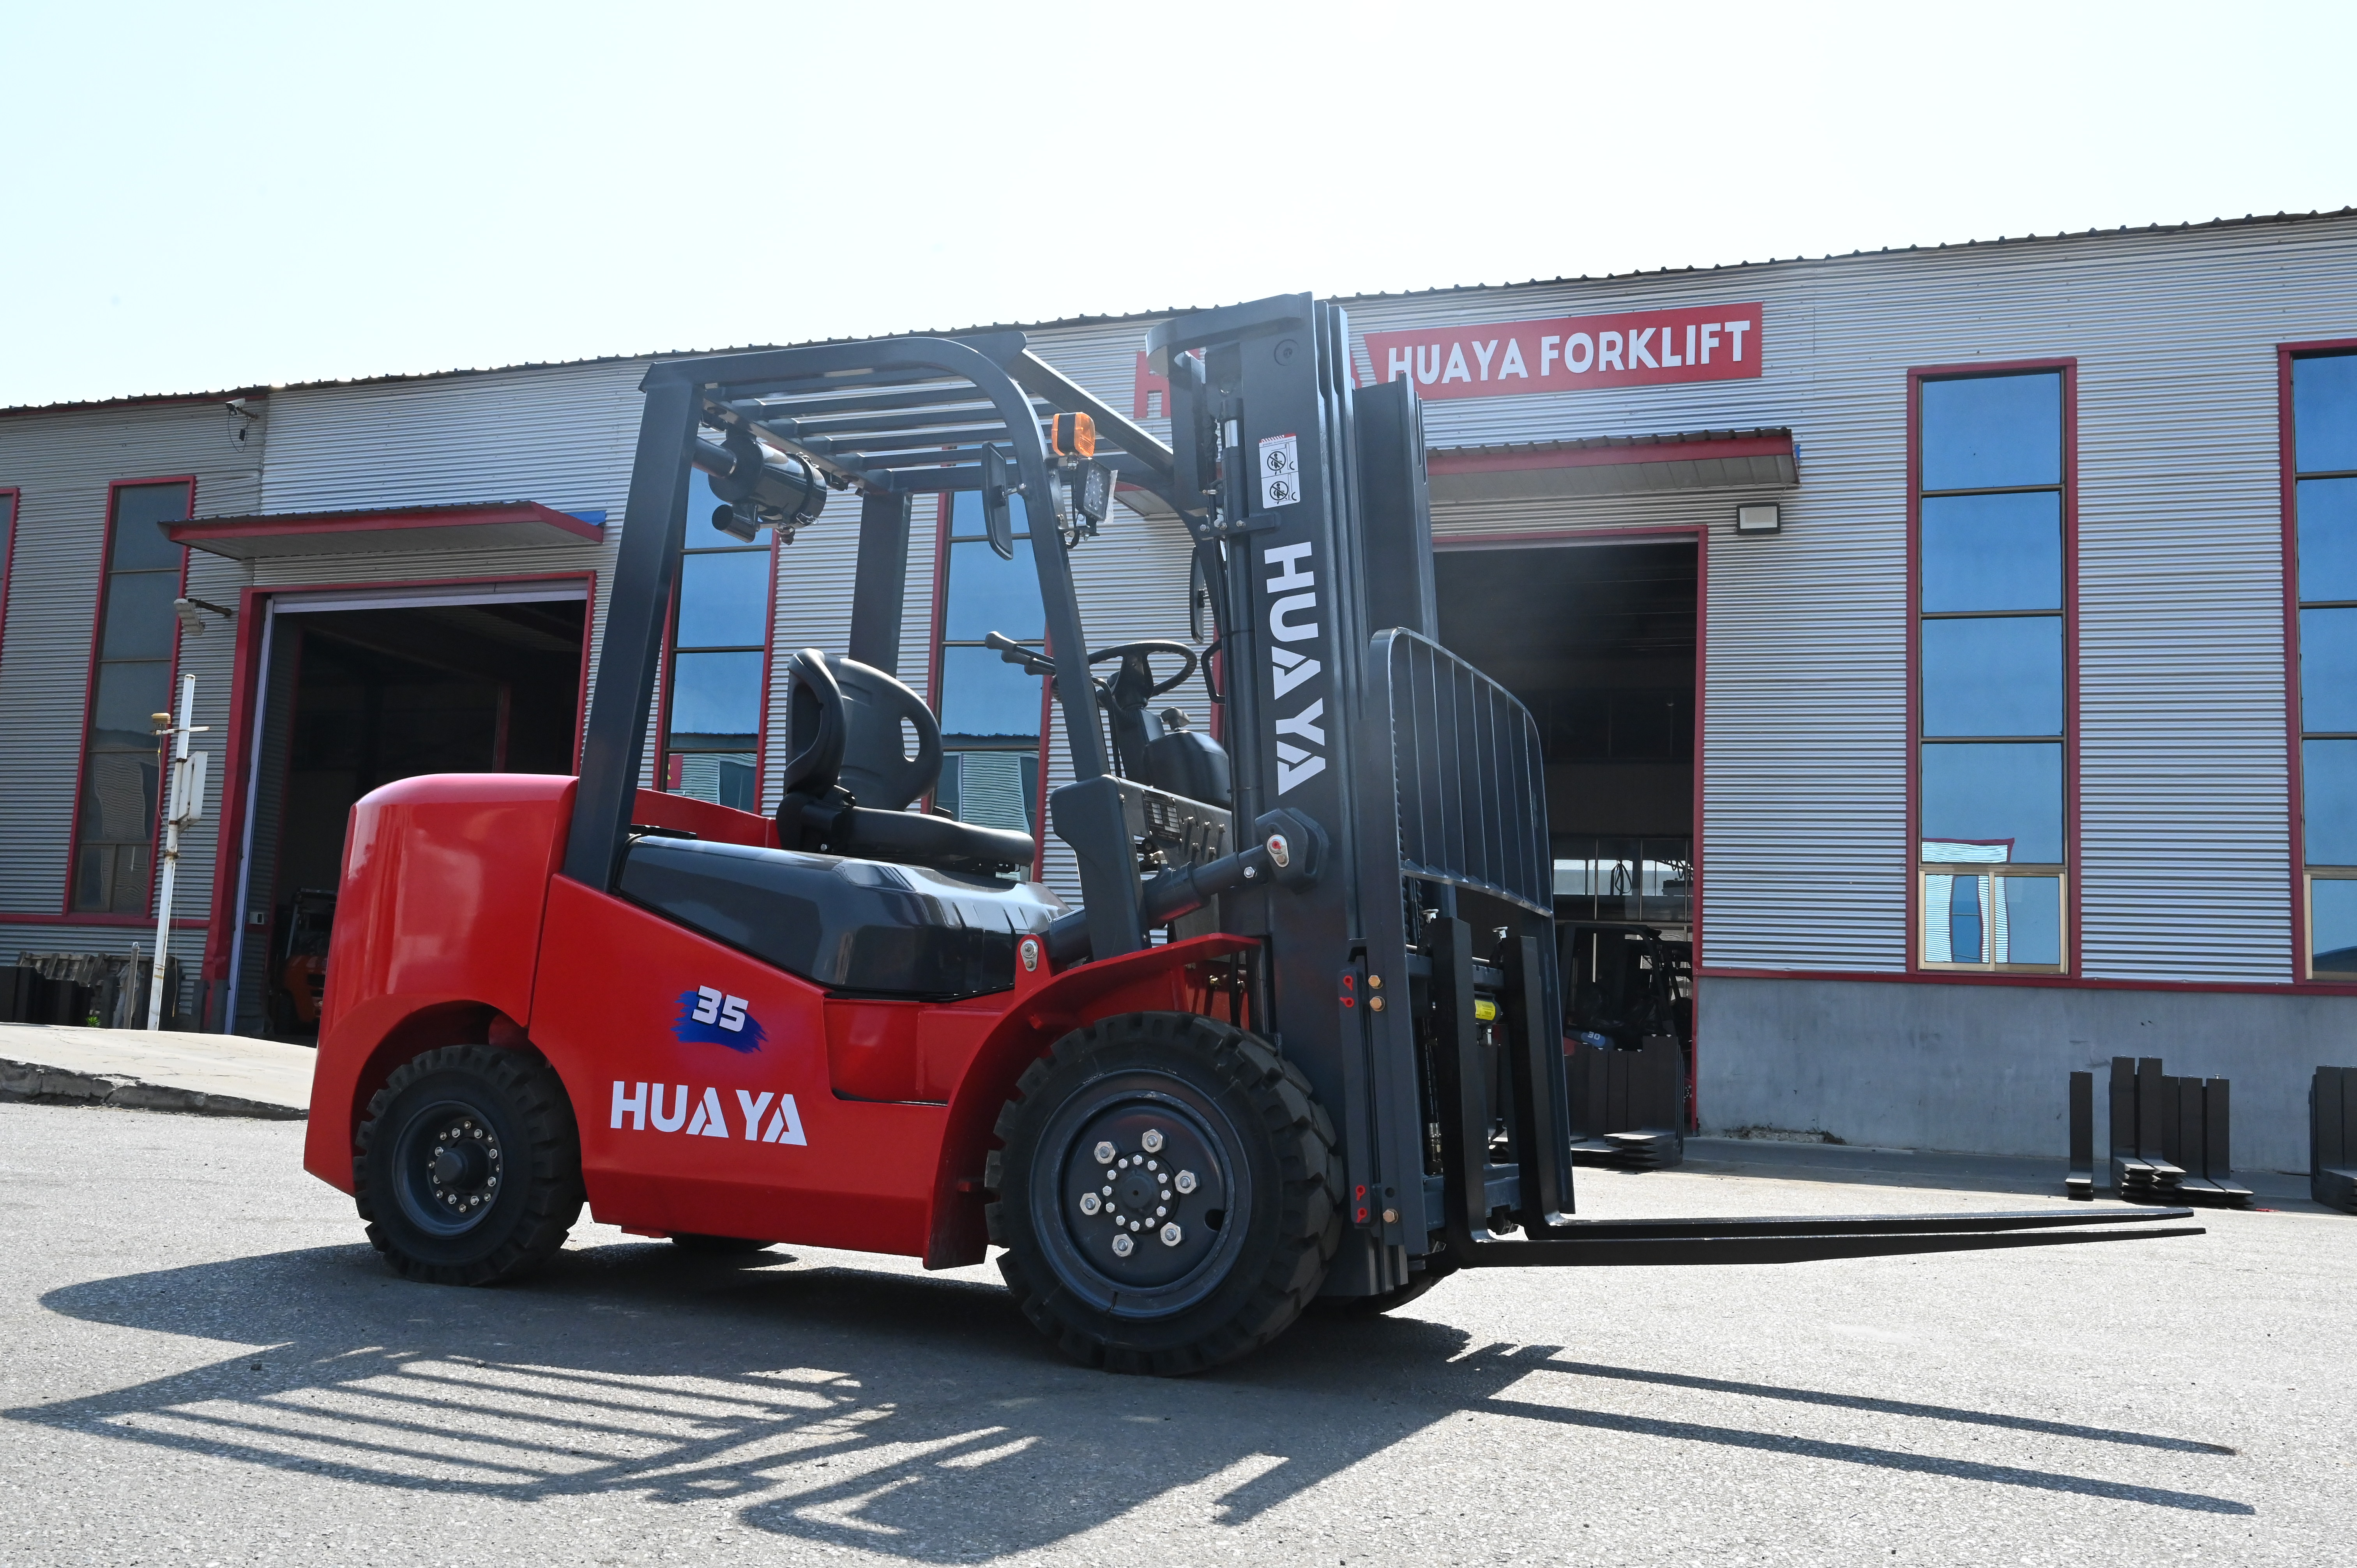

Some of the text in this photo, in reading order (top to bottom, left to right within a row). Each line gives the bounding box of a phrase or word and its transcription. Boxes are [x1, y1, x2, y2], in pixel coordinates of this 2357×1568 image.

[1388, 338, 1528, 385] HUAYA
[1541, 320, 1750, 377] FORKLIFT
[1264, 541, 1326, 796] HUAYA
[691, 985, 749, 1032] 35
[1587, 1031, 1601, 1040] 30
[610, 1081, 807, 1146] HUAYA
